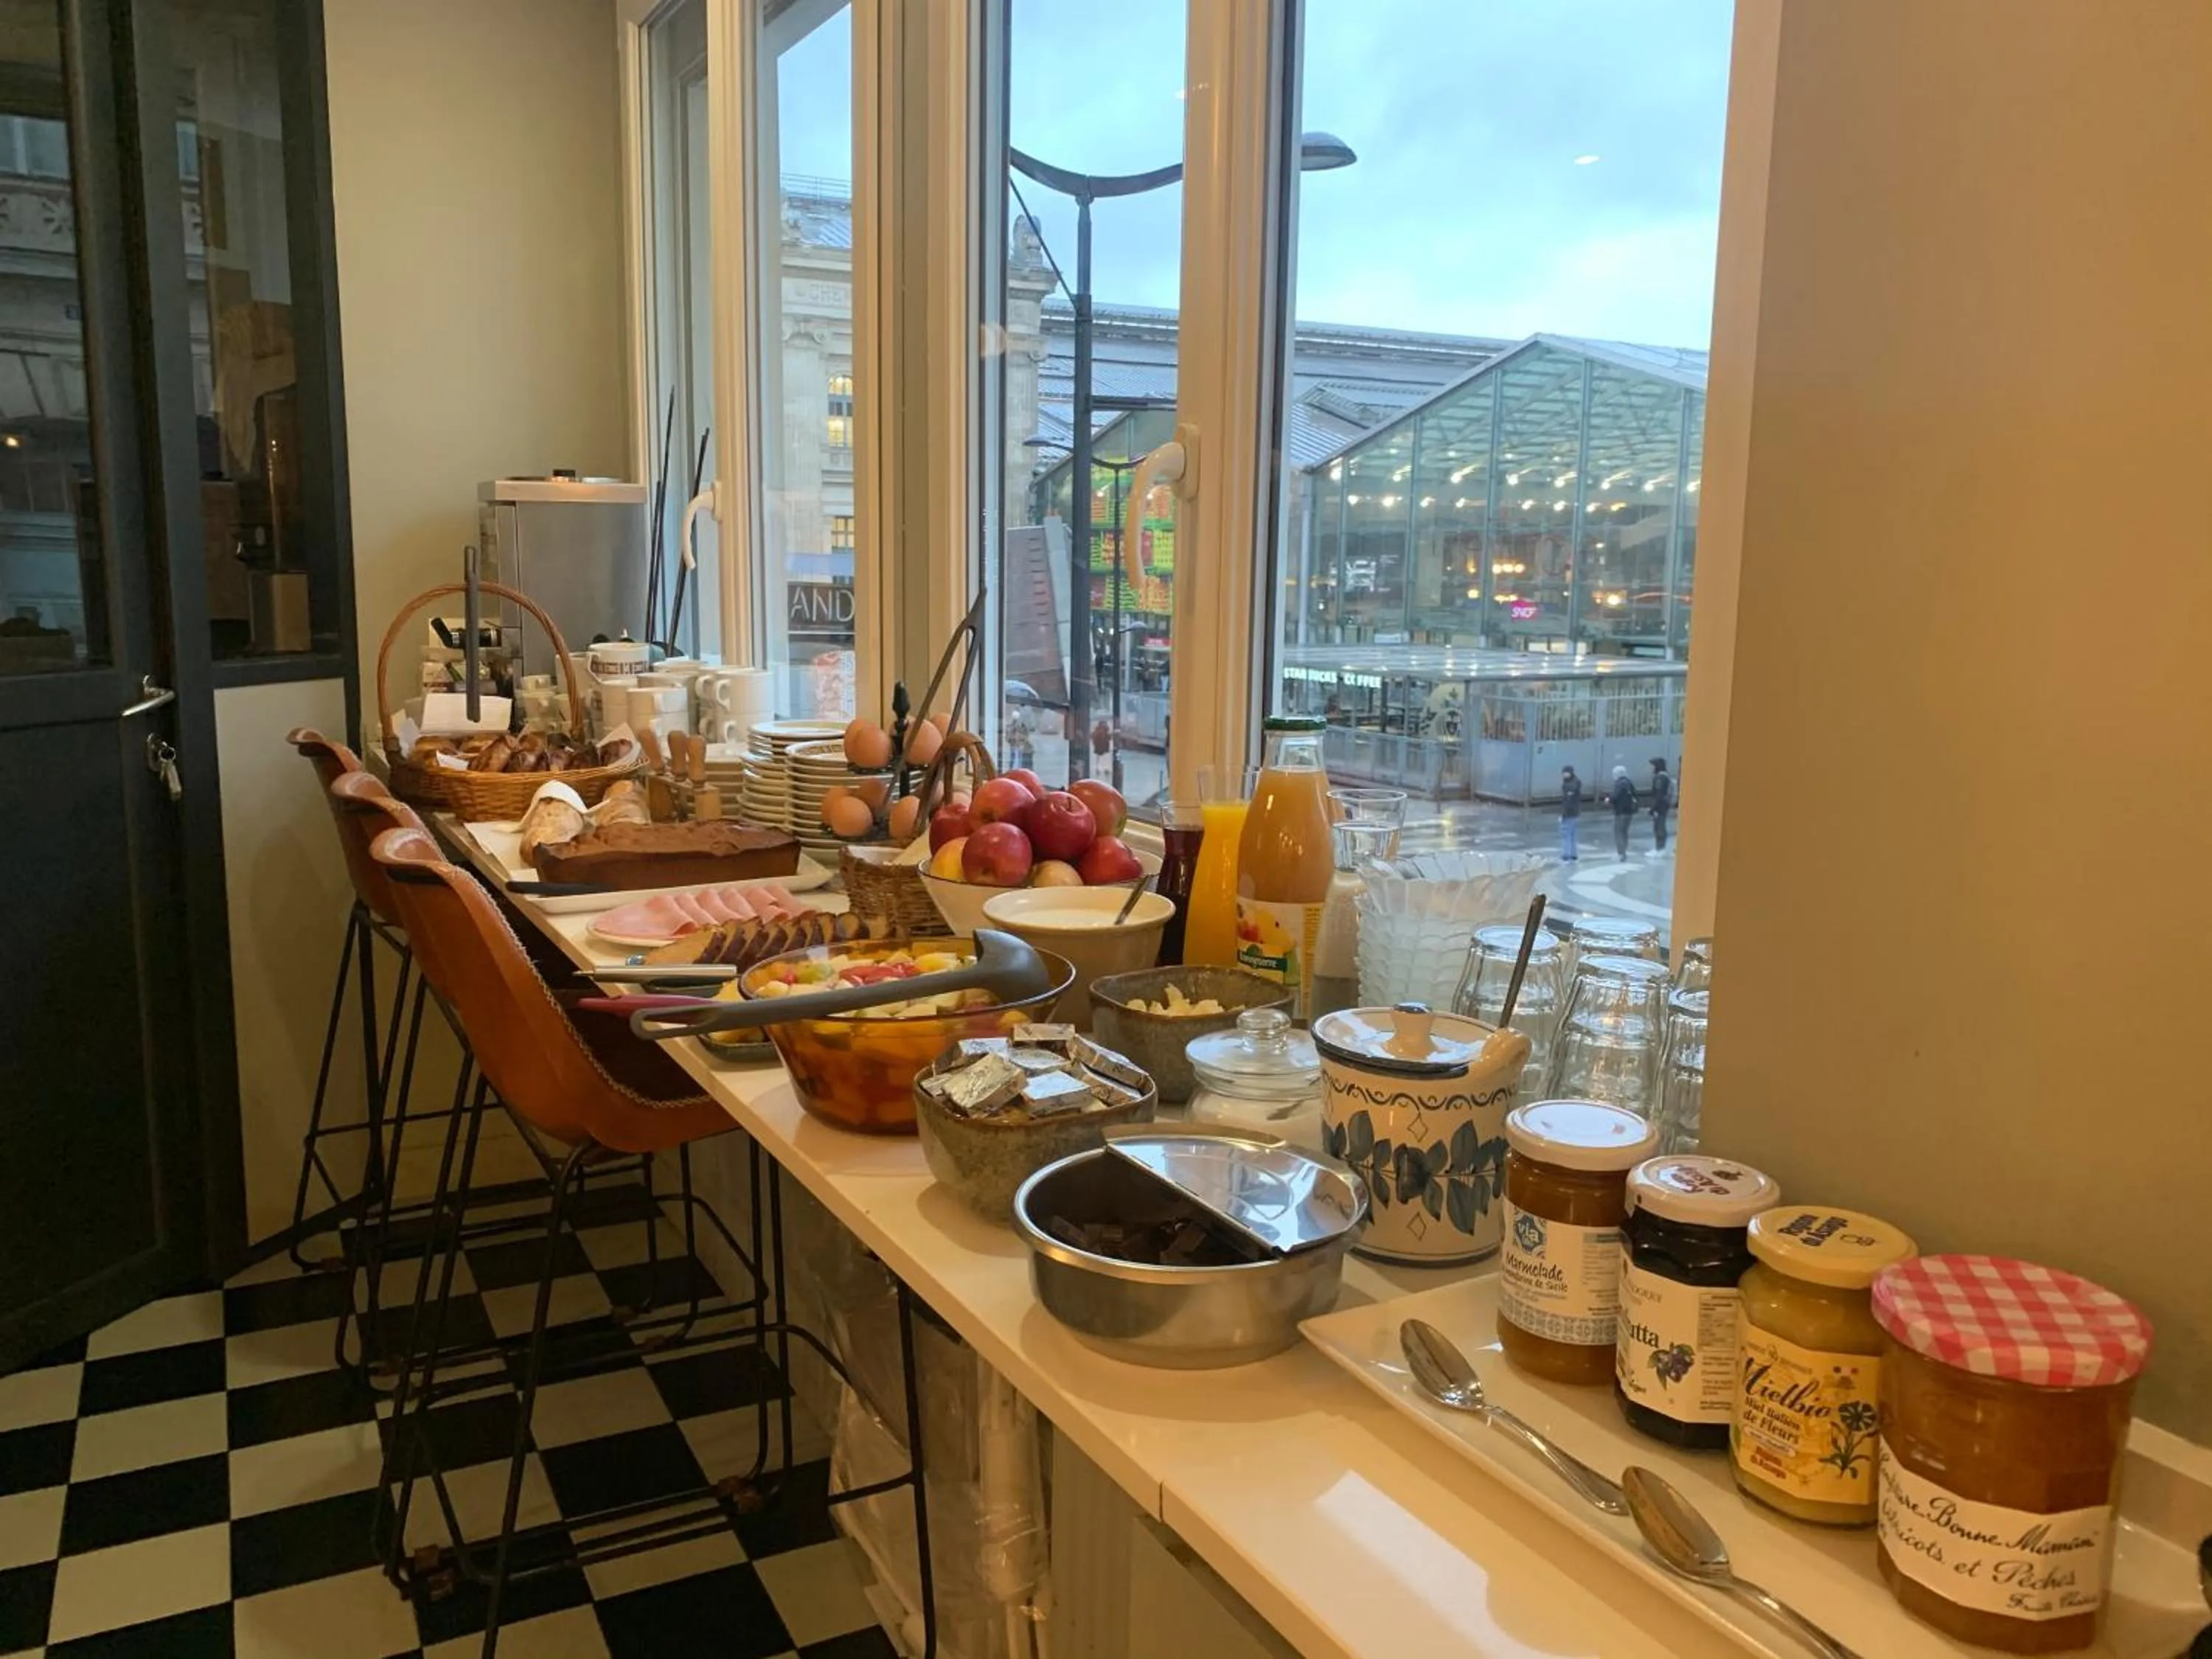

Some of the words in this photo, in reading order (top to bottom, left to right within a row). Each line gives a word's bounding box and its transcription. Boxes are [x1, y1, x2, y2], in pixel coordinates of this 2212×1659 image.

[790, 587, 855, 622] AND
[1511, 607, 1537, 618] SNCF
[1506, 1251, 1563, 1282] Marmelade
[1759, 1416, 1800, 1444] Fleurs
[1927, 1497, 2001, 1546] Bonne
[2006, 1523, 2096, 1555] Maman
[1954, 1559, 1982, 1577] et
